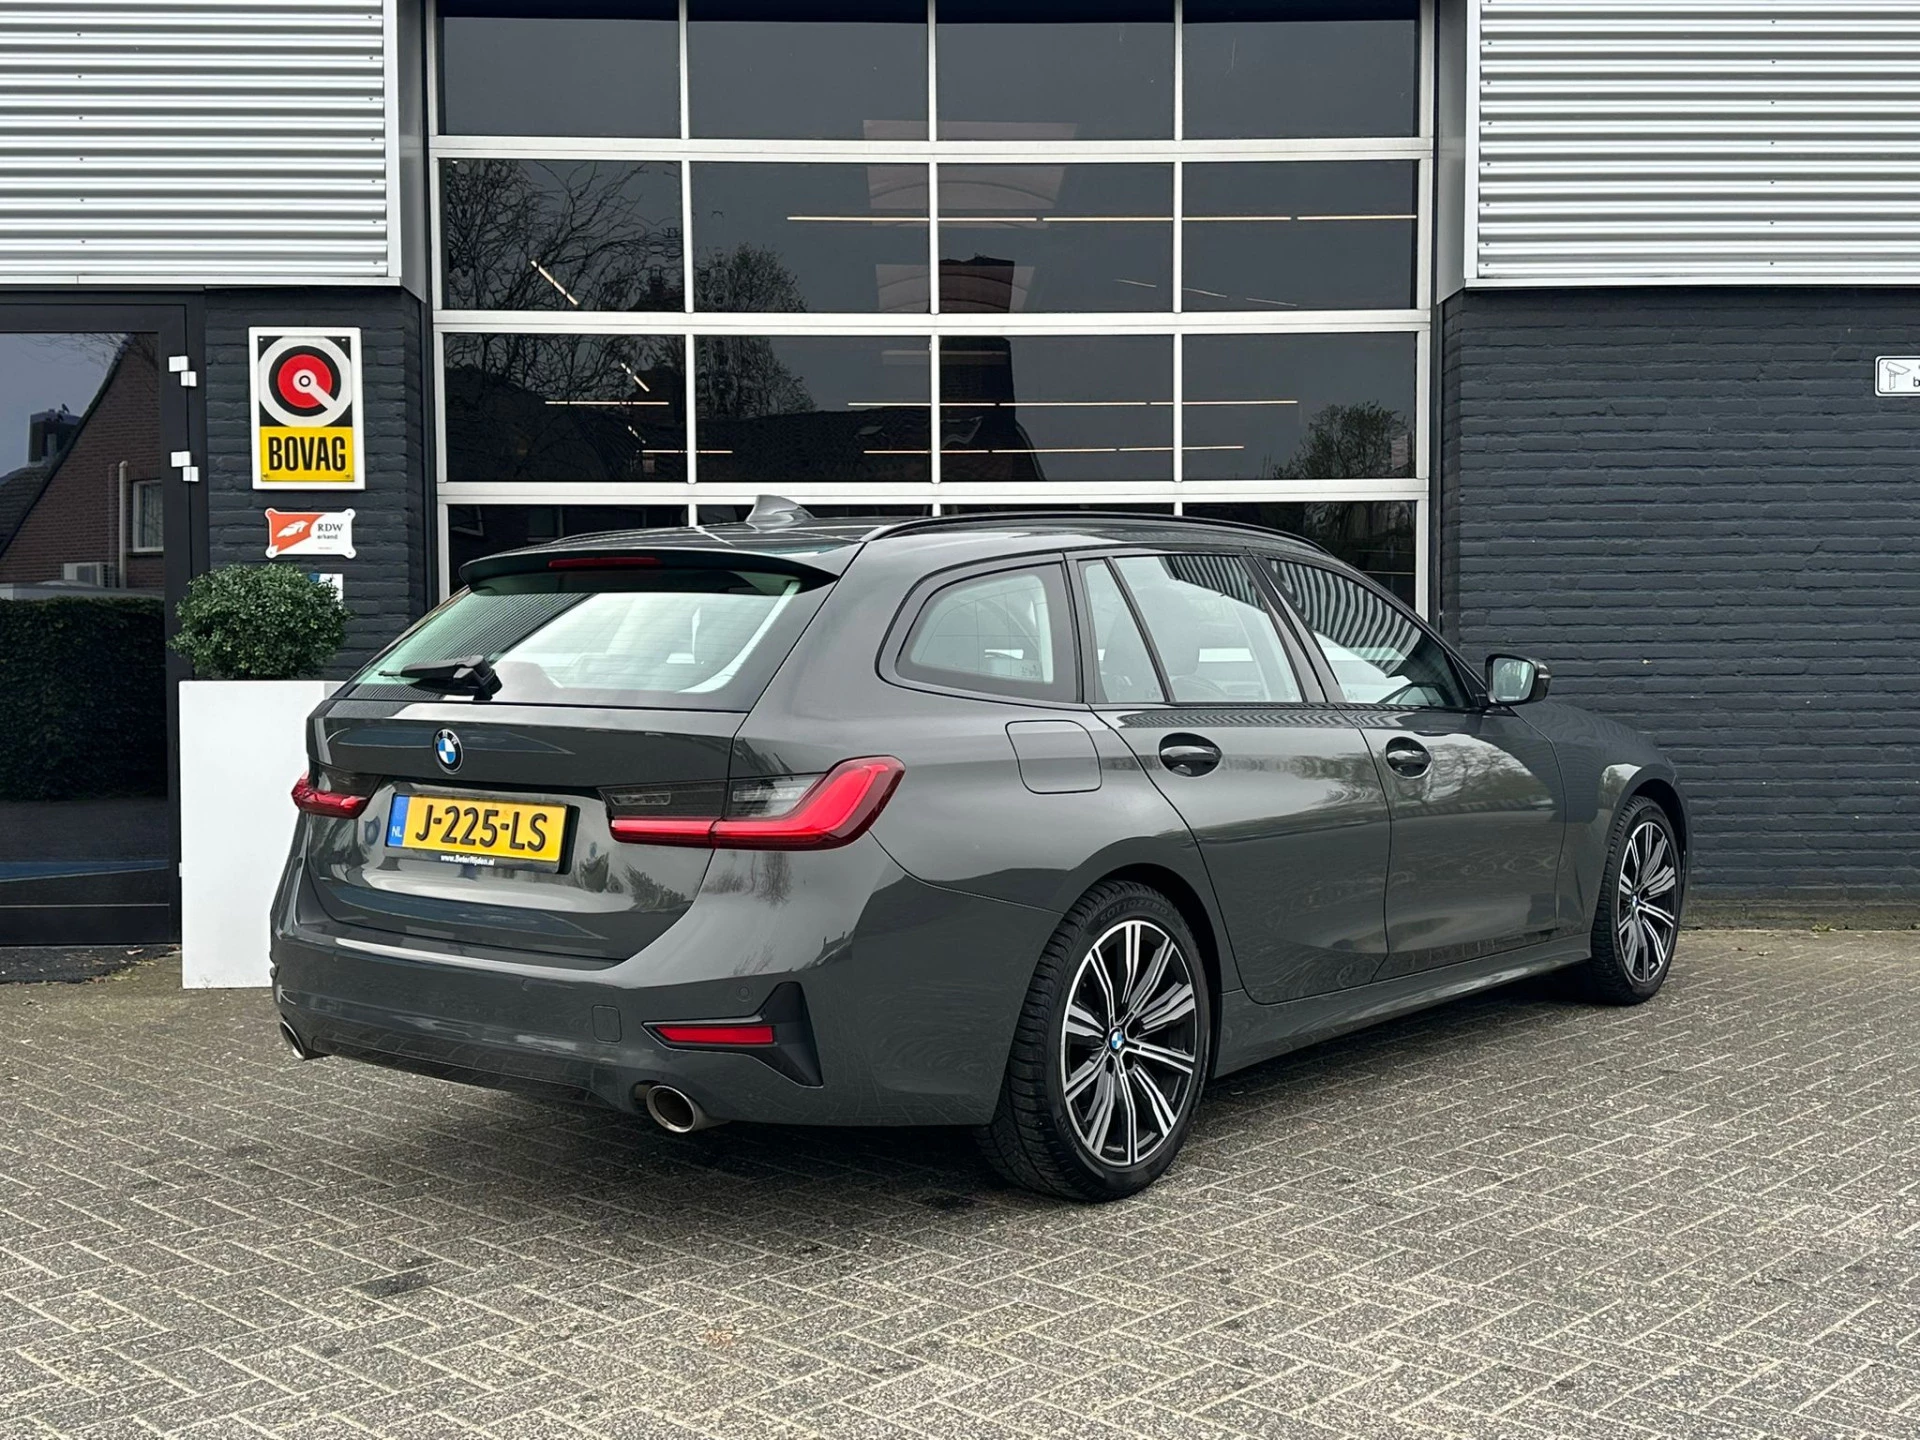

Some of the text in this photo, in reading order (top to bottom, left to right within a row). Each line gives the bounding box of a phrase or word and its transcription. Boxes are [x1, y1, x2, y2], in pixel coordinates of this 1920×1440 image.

[268, 436, 346, 472] BOVAG
[317, 523, 343, 532] RDW
[391, 825, 403, 838] NL
[415, 804, 548, 851] J-225-LS
